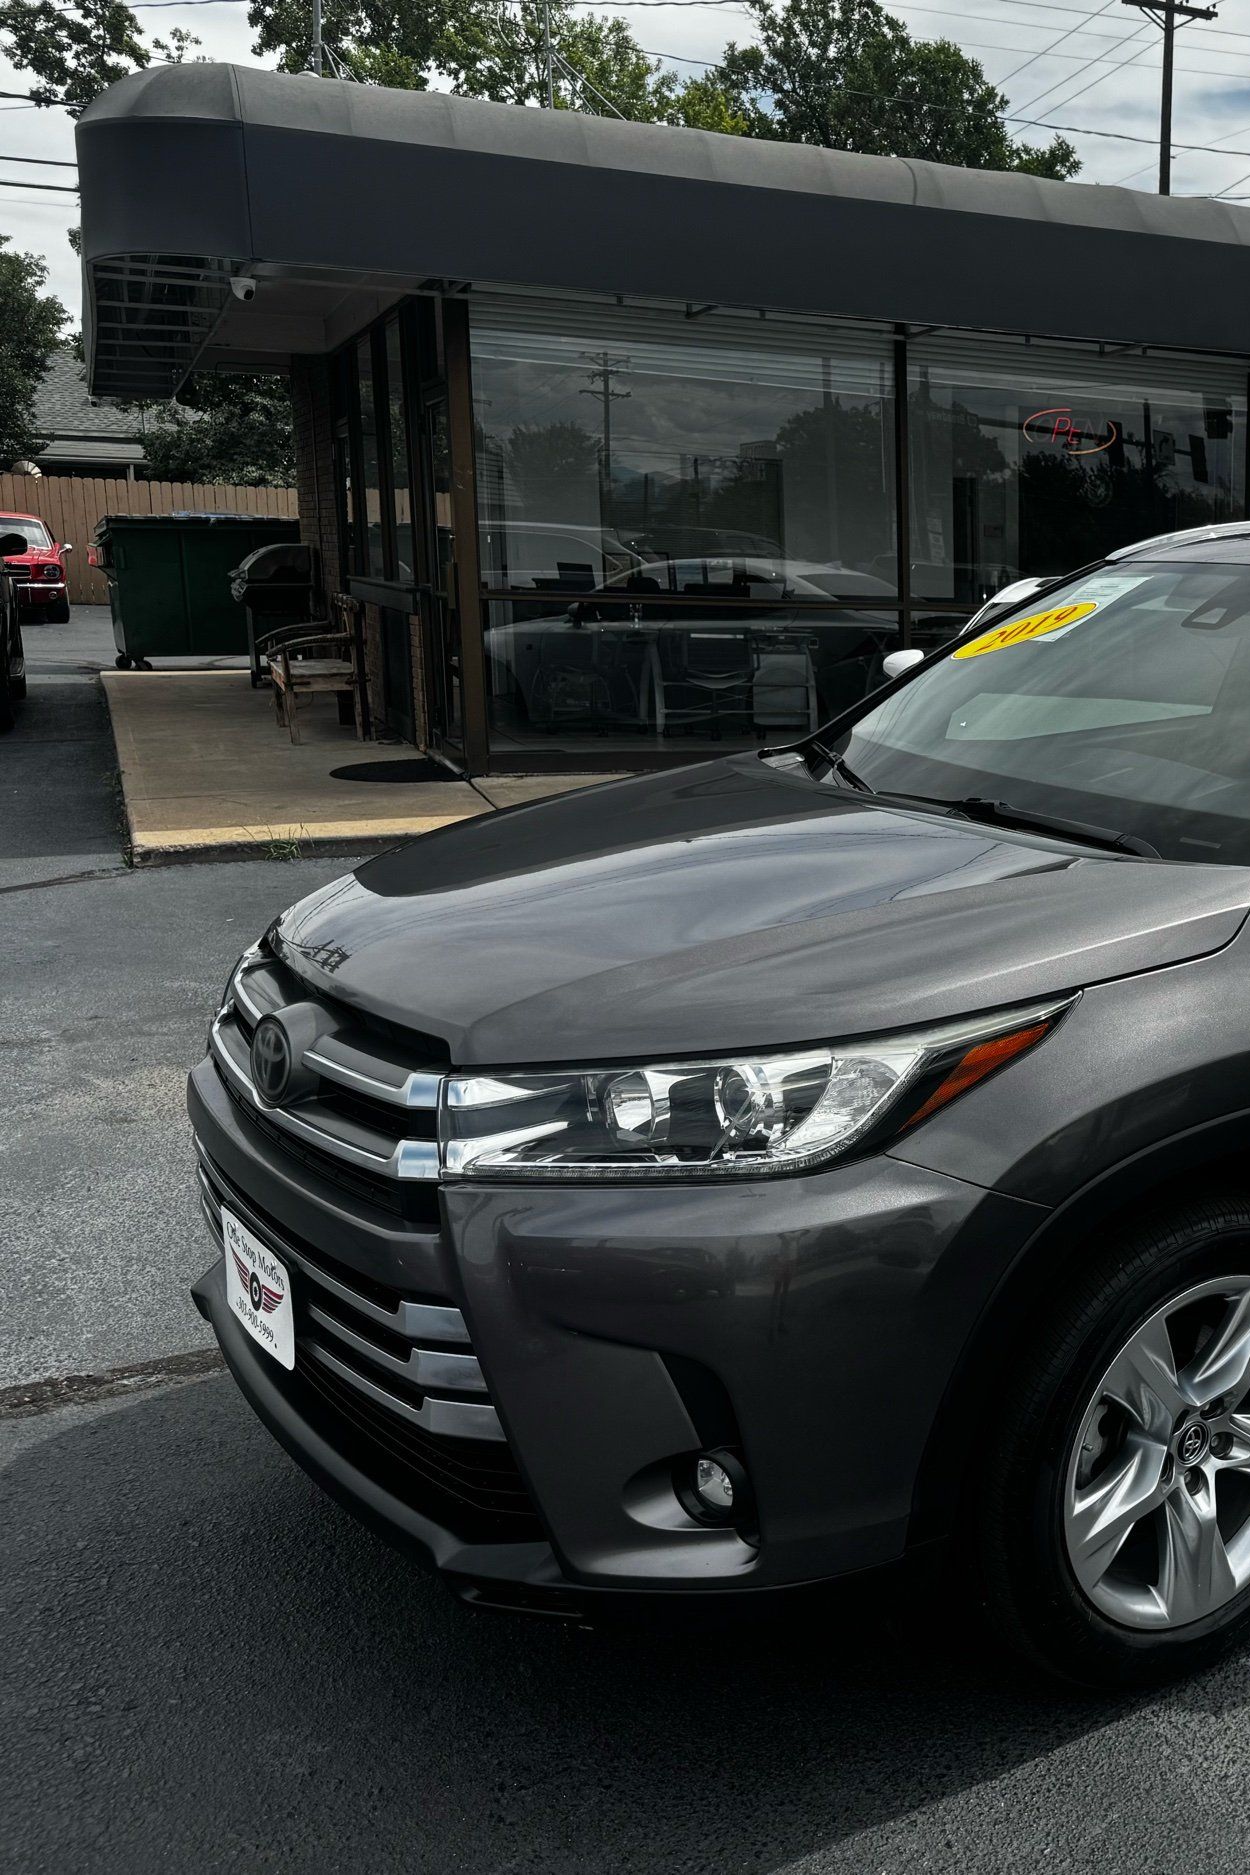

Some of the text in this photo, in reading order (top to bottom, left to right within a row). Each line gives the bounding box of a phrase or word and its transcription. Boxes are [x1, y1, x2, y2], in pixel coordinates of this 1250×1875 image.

[975, 606, 1077, 652] 2019
[227, 1221, 284, 1290] One Stop Motors
